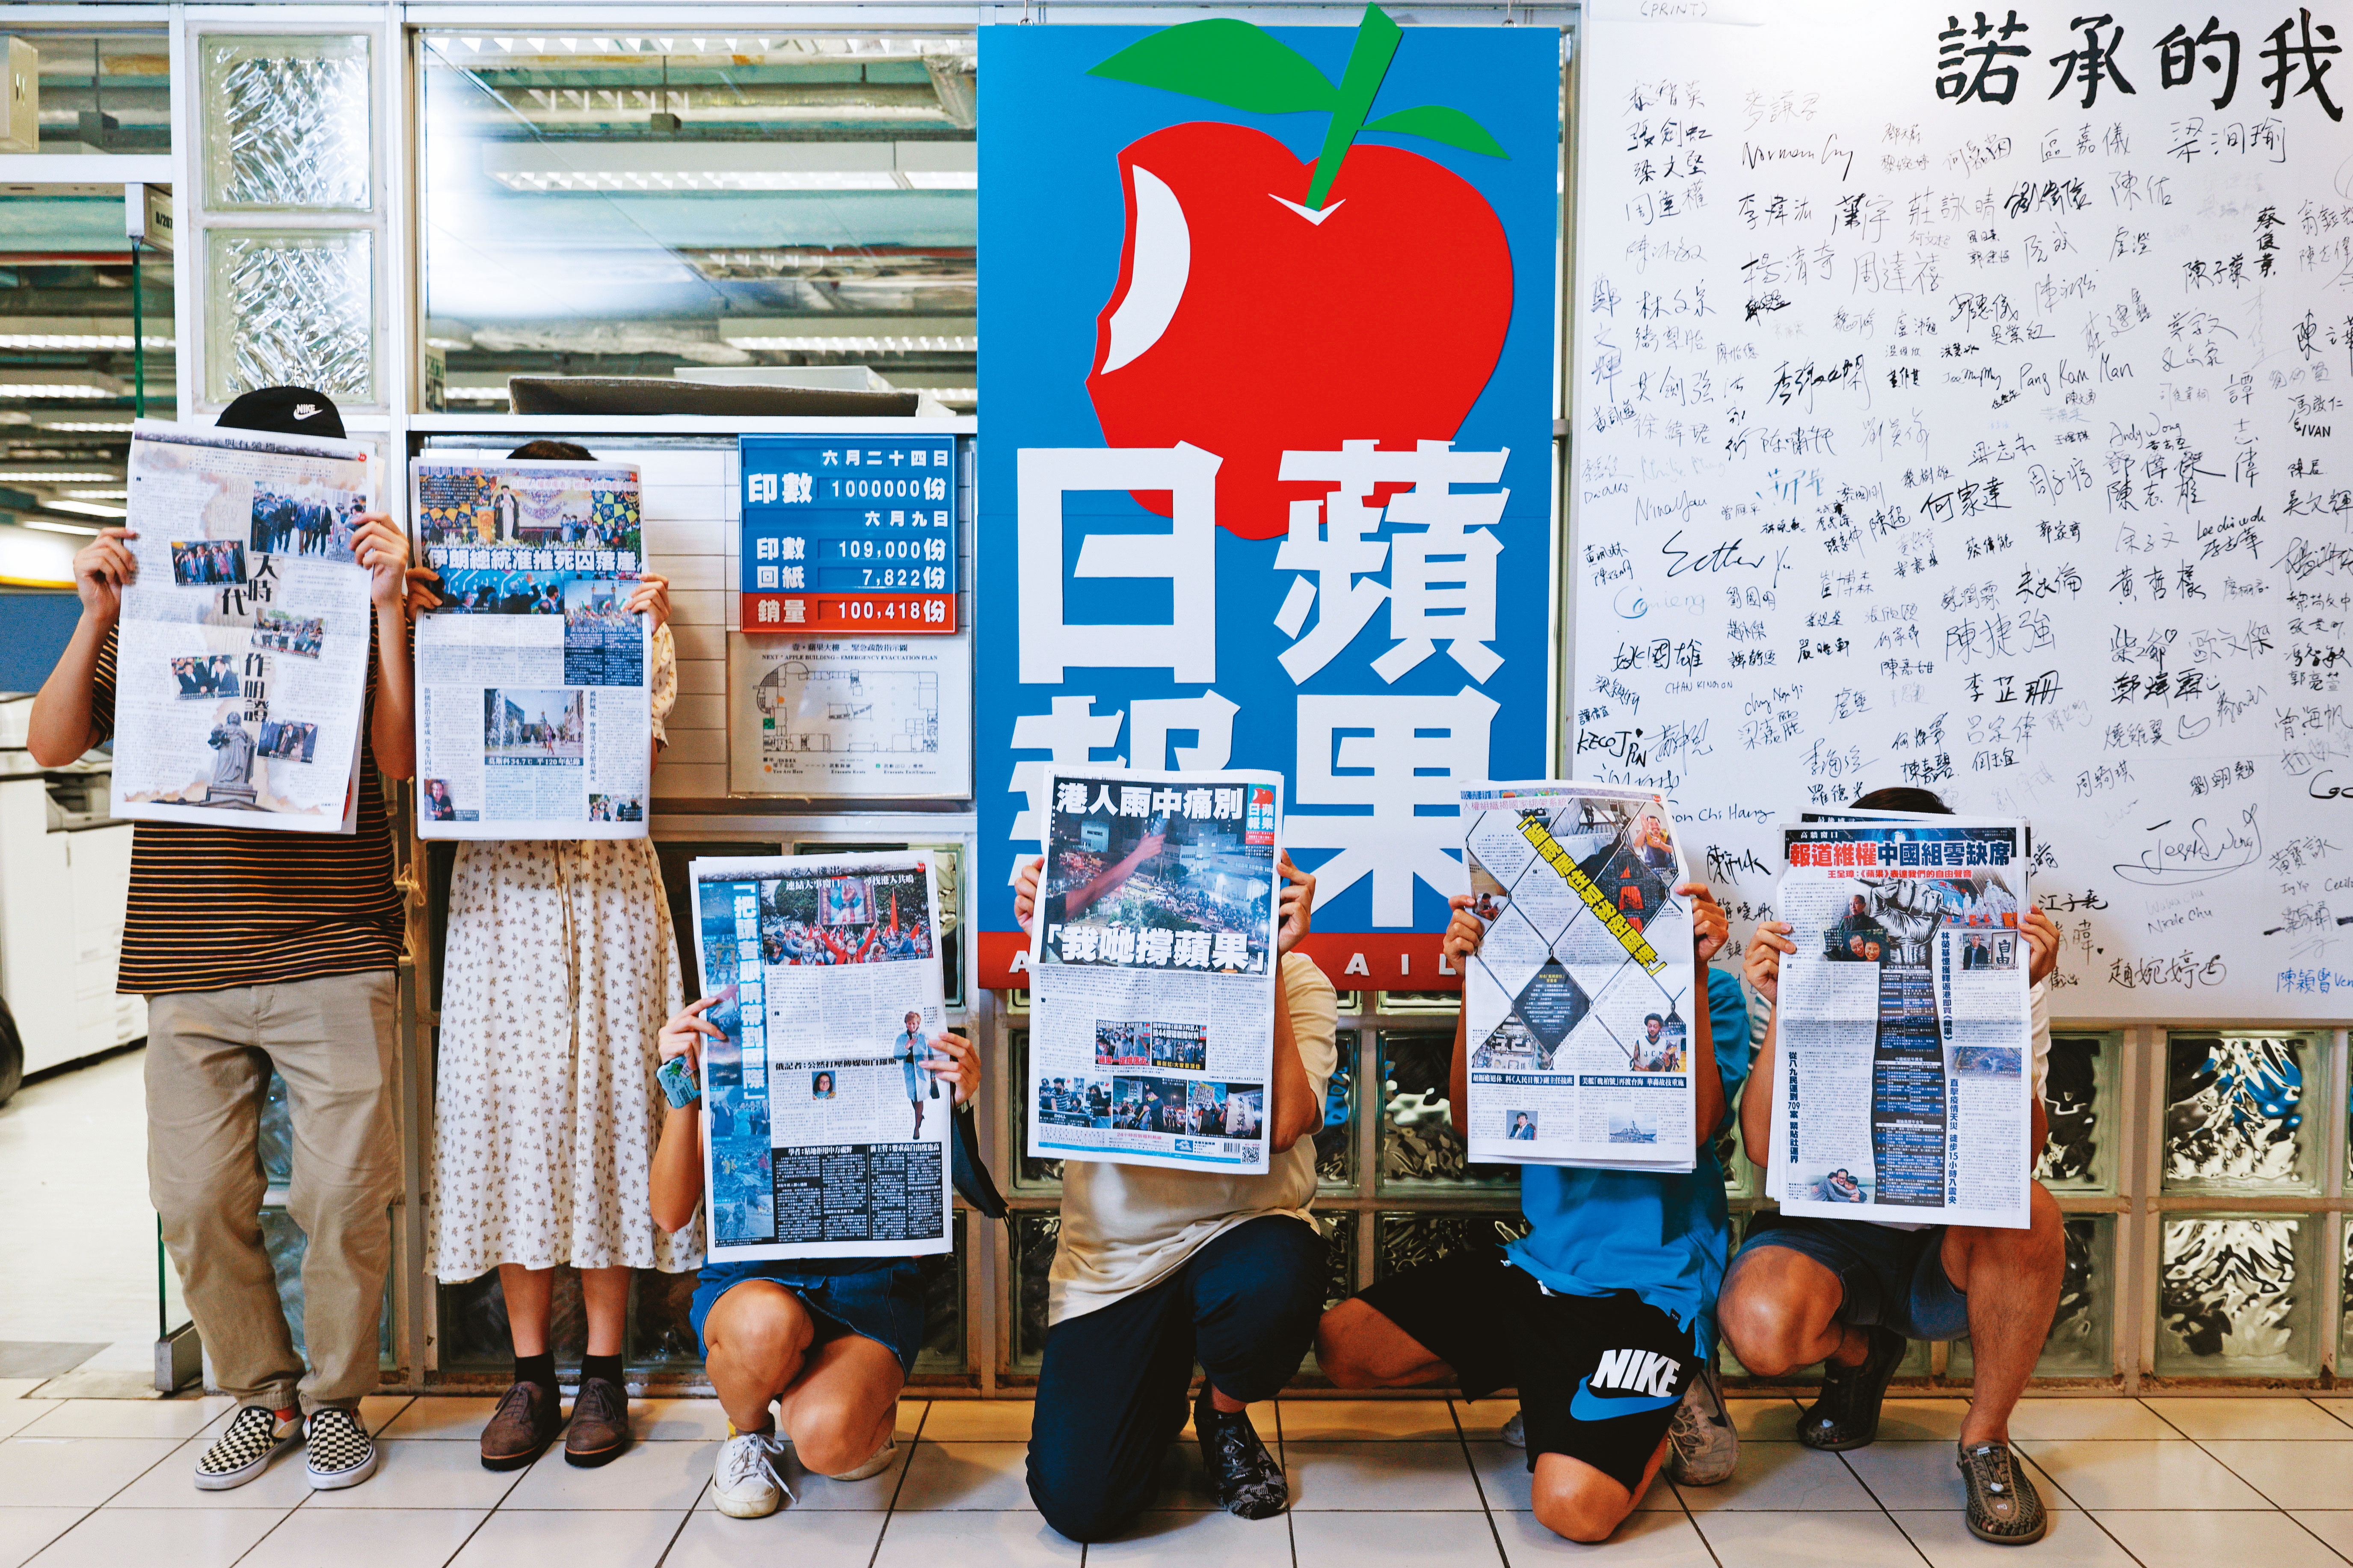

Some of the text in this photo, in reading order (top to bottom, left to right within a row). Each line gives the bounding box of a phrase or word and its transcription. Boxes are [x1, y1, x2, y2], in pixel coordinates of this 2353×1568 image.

[1627, 117, 1713, 151] 張劍虹
[2042, 123, 2130, 163] 區嘉儀
[2021, 363, 2050, 395] Pang
[2101, 353, 2133, 382] Man
[297, 404, 315, 414] NIKE
[2301, 424, 2330, 437] IVAN
[823, 450, 948, 467] 六月二十四日
[748, 473, 946, 503] 印數 1000000份
[865, 511, 948, 527] 六月九日
[757, 537, 946, 561] 印數 109,000份
[757, 565, 945, 589] 回紙 7,822份
[758, 599, 945, 623] 銷量 100,418份
[1665, 683, 1695, 693] CHAN
[1056, 782, 1245, 820] 港人雨中痛別
[1463, 797, 1568, 811] 人權組織揭國家綁架系統
[1699, 809, 1722, 820] Chi
[1048, 924, 1265, 972] 「我哋撐蘋果」
[1590, 1349, 1680, 1397] NIKE
